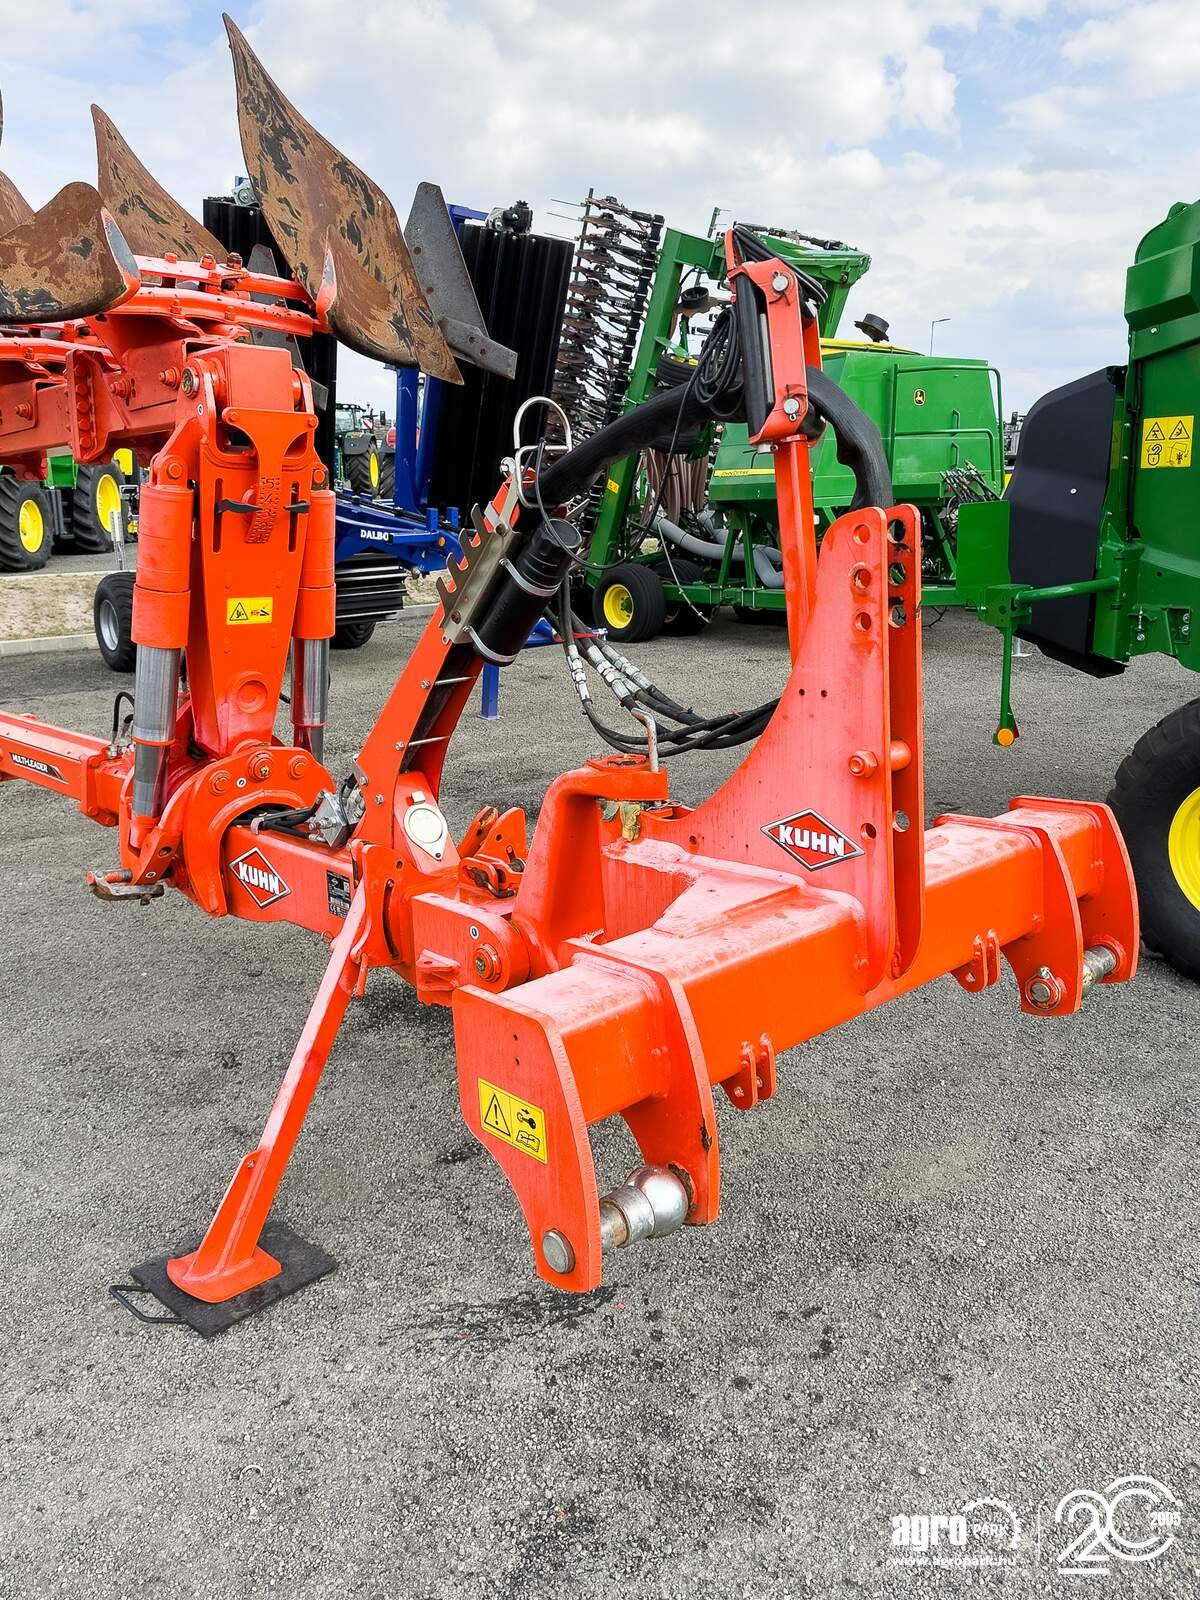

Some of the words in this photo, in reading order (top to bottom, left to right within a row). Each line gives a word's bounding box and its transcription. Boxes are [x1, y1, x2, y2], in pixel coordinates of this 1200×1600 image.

[360, 529, 389, 541] DALBO
[778, 824, 845, 857] KUHN
[238, 861, 280, 896] KUHN
